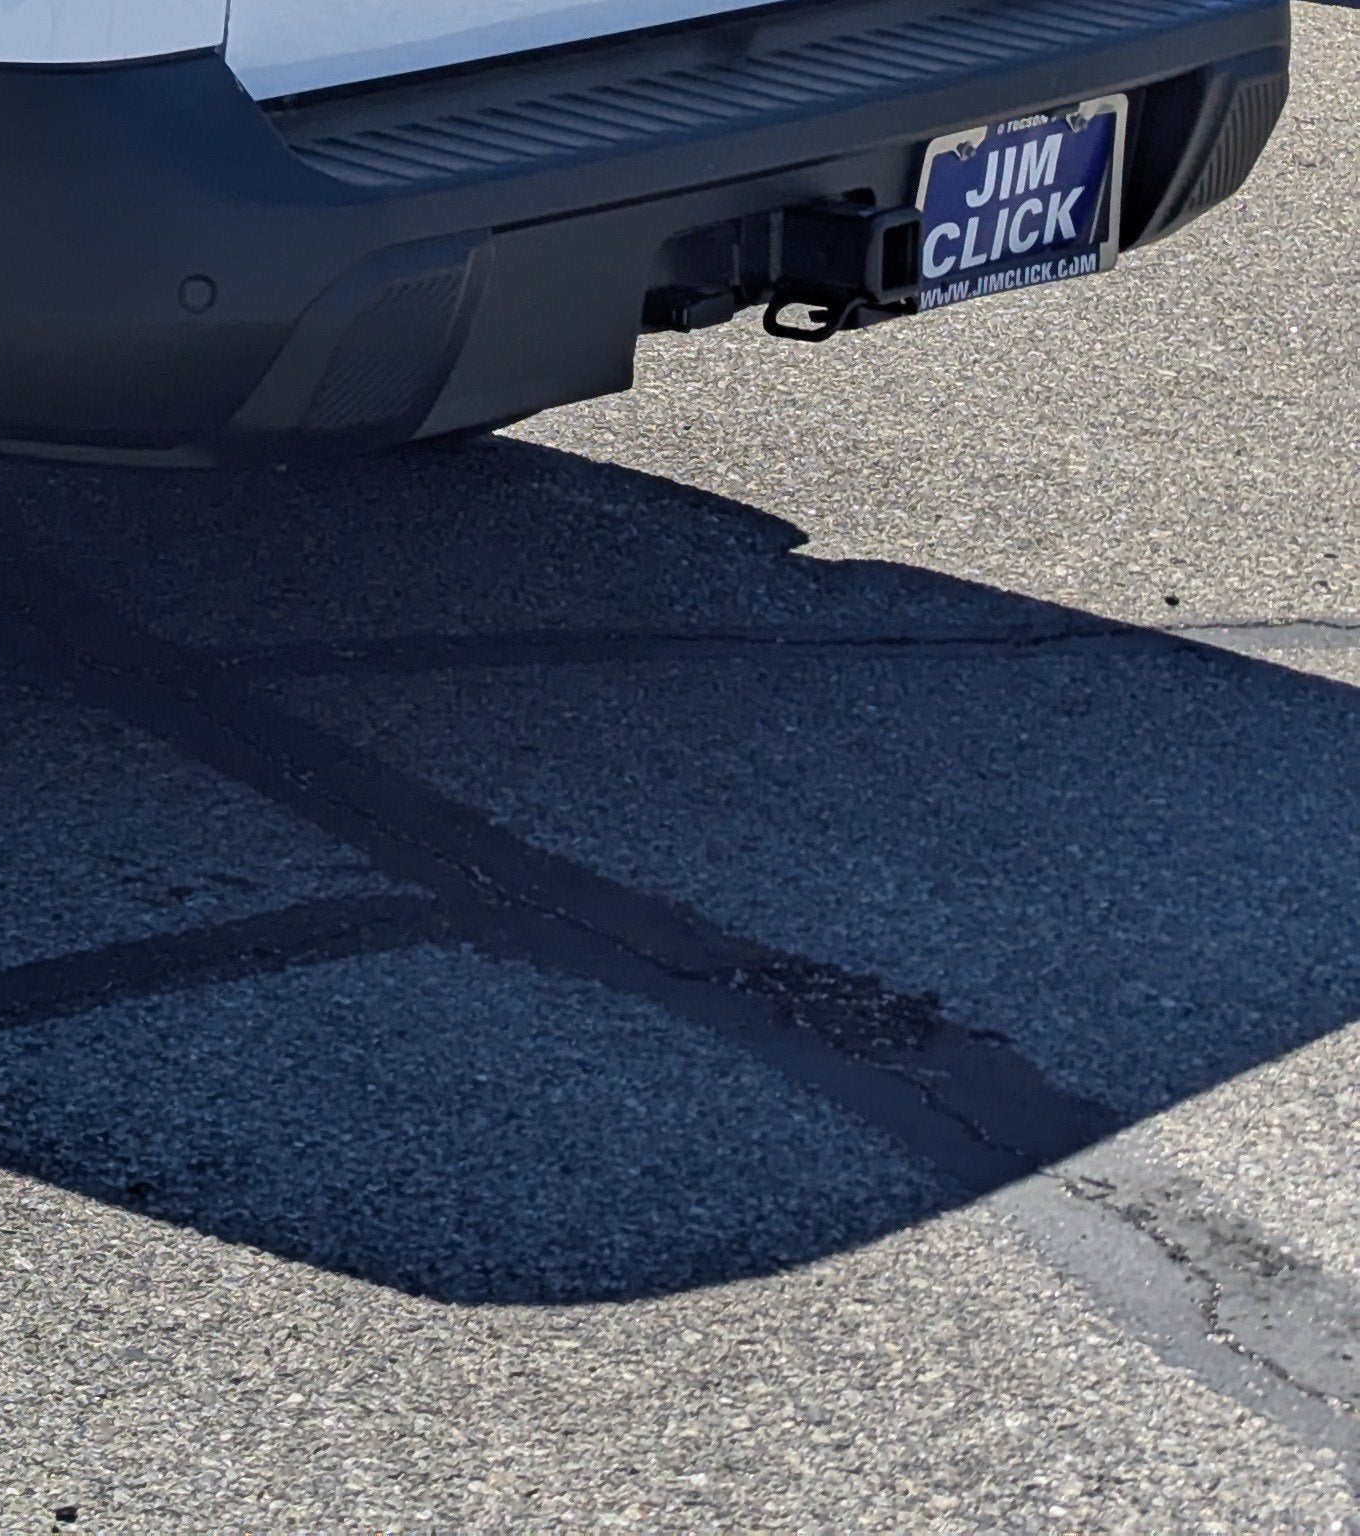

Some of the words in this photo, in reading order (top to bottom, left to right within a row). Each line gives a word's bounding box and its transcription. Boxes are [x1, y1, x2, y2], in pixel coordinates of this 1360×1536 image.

[965, 132, 1064, 208] JIM
[922, 185, 1086, 279] CLICK
[920, 252, 1097, 310] WWW.JIMCLICK.COM
